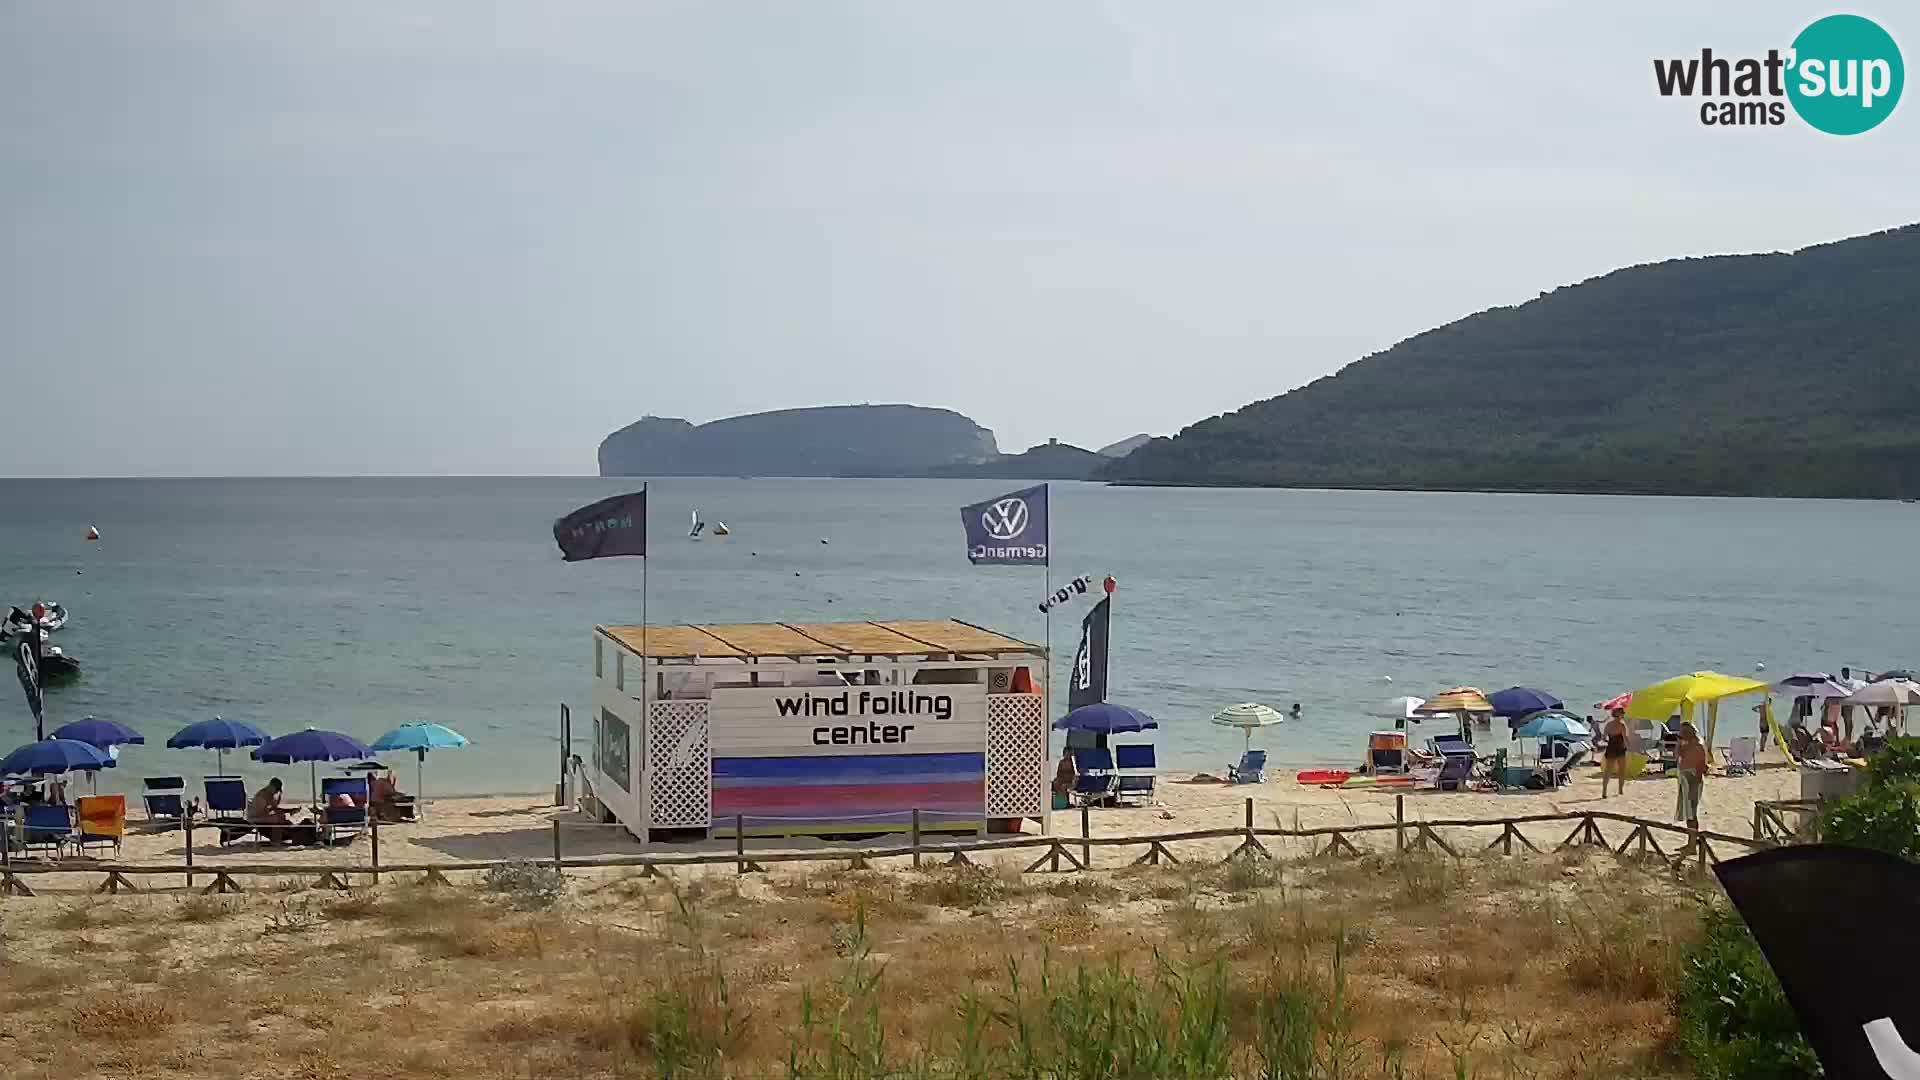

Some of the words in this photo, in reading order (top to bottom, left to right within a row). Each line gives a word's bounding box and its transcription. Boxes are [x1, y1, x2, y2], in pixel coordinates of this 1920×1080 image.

[775, 691, 848, 716] wind
[859, 690, 952, 720] foiling
[813, 721, 914, 745] center
